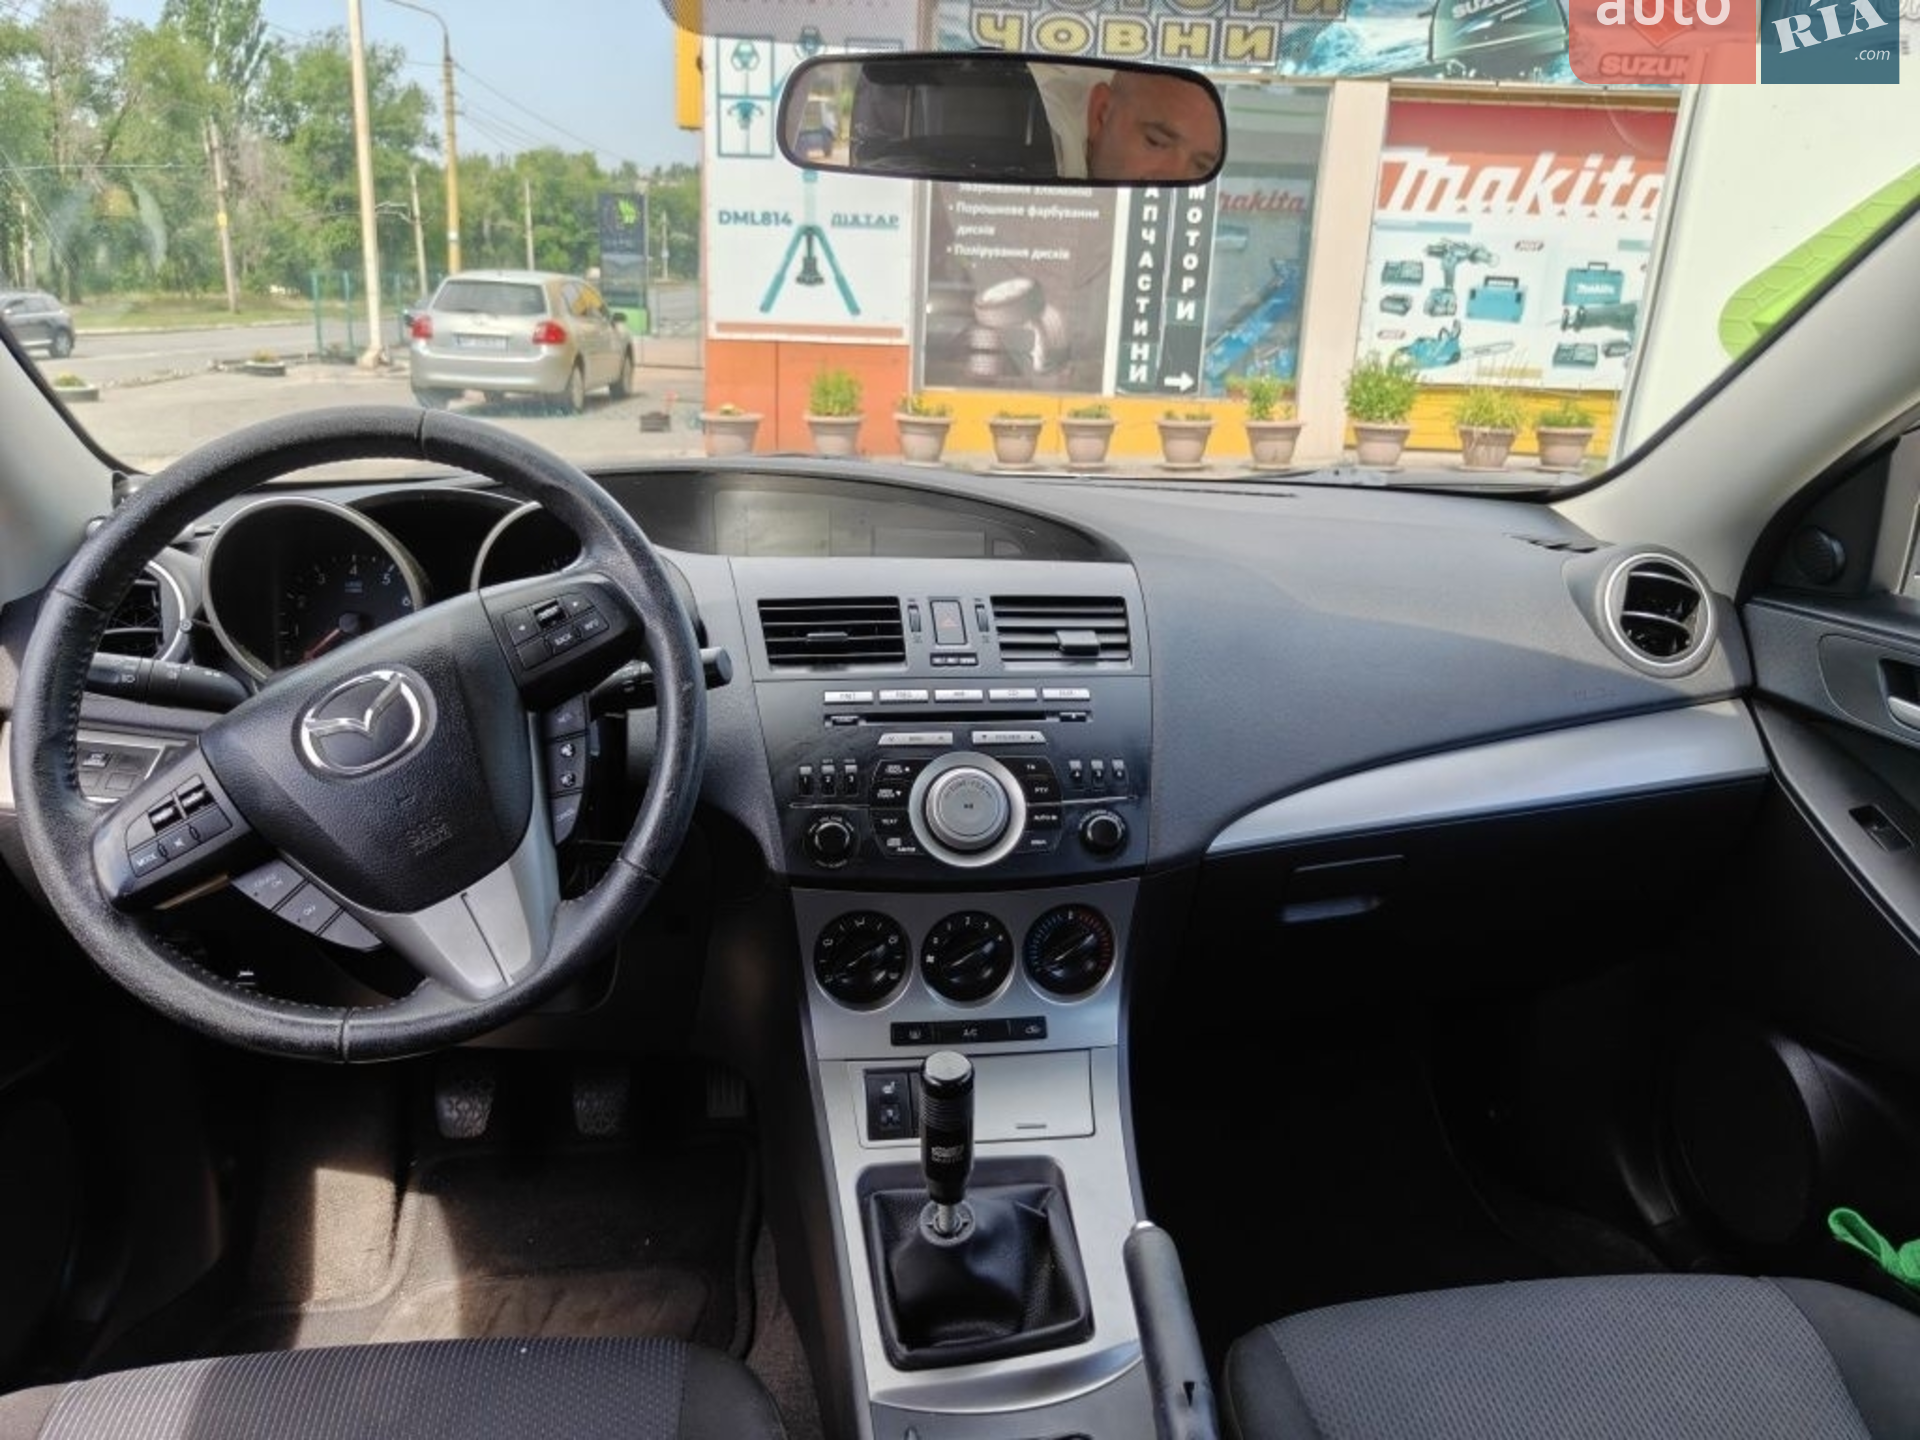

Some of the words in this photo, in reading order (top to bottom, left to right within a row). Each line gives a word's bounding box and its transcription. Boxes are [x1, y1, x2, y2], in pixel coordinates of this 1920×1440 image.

[970, 12, 1278, 65] ЧОВНИ
[718, 210, 793, 227] DML814
[1175, 185, 1207, 321] МОТОРИ
[382, 573, 391, 586] 5
